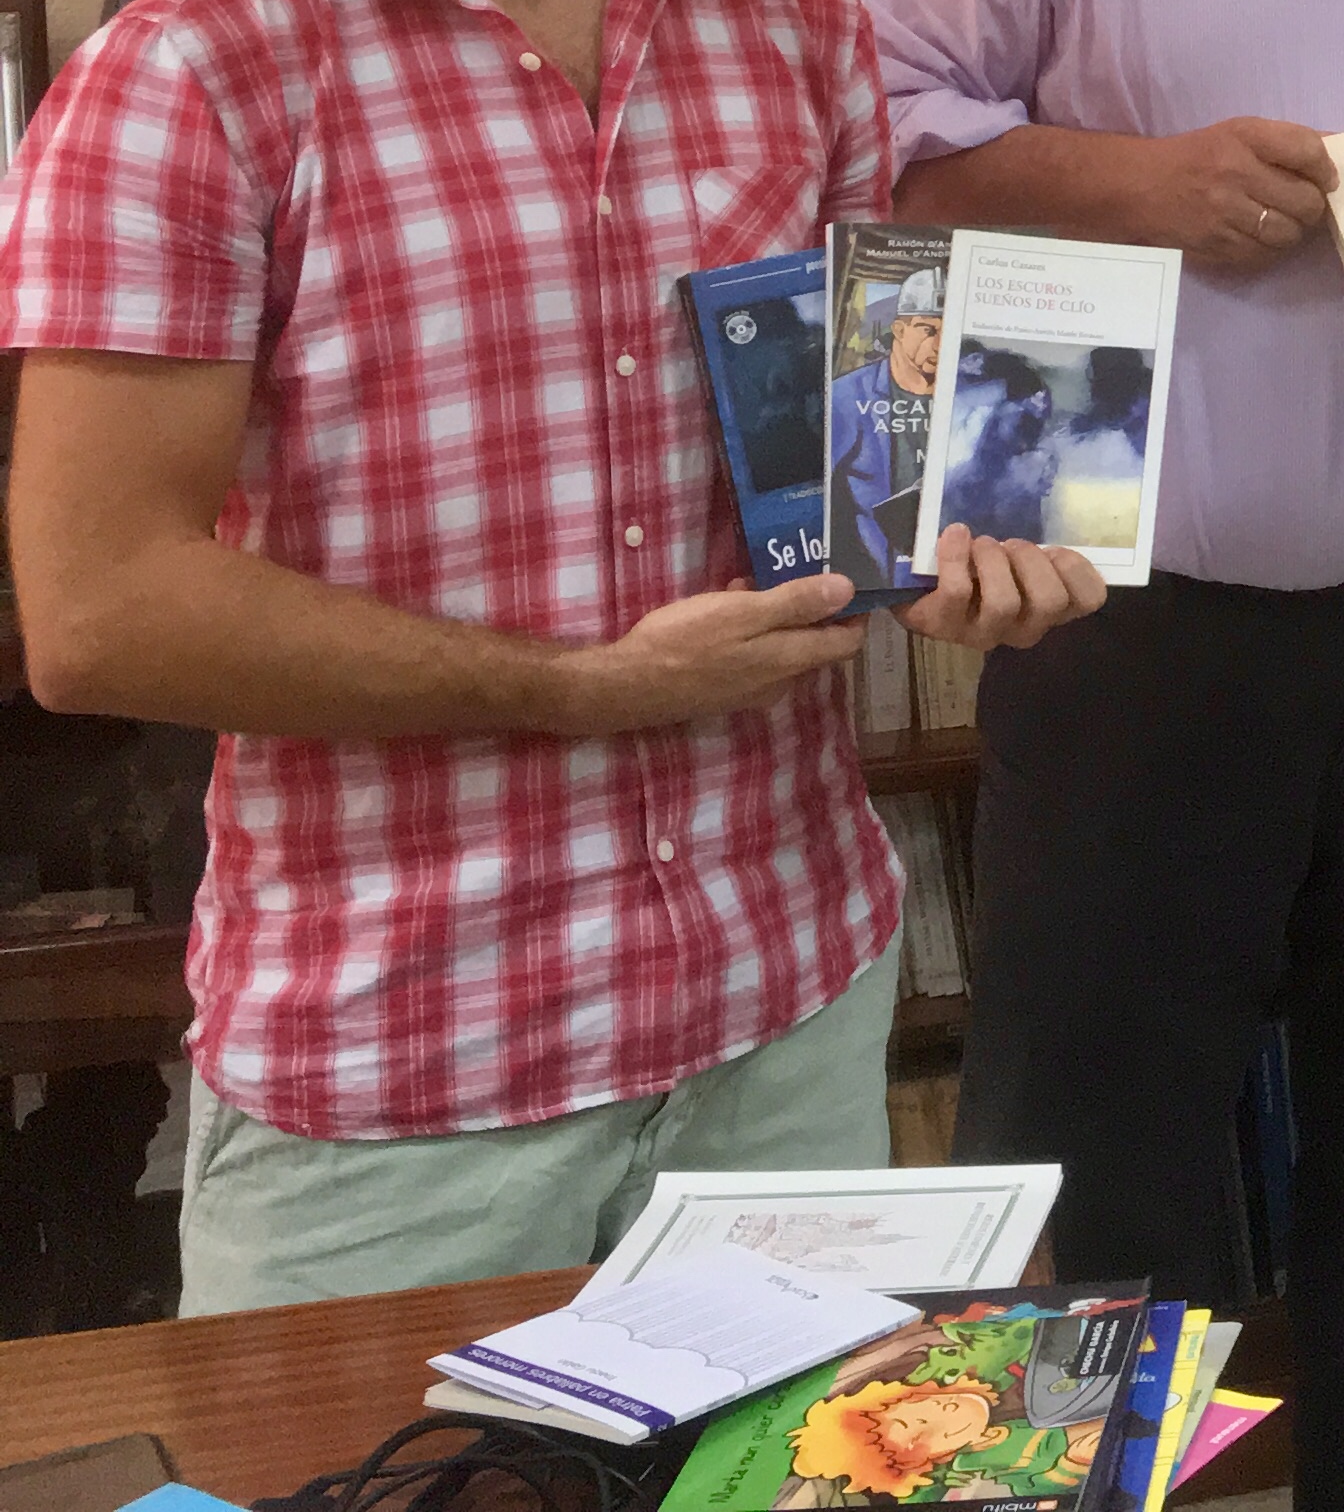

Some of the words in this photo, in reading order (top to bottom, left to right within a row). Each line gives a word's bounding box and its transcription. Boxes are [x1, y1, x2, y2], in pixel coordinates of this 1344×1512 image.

[866, 249, 909, 258] MANUEL
[978, 256, 1009, 268] Carlos
[976, 276, 1004, 290] LOS
[1007, 279, 1073, 297] ESCUROS
[974, 292, 1032, 309] SUEÑOS
[1035, 297, 1057, 311] DE
[1059, 299, 1096, 314] CLÍO
[767, 538, 796, 572] Se
[467, 1347, 528, 1373] menores
[526, 1368, 592, 1394] pallabres
[587, 1388, 609, 1400] en
[608, 1395, 653, 1418] Patria
